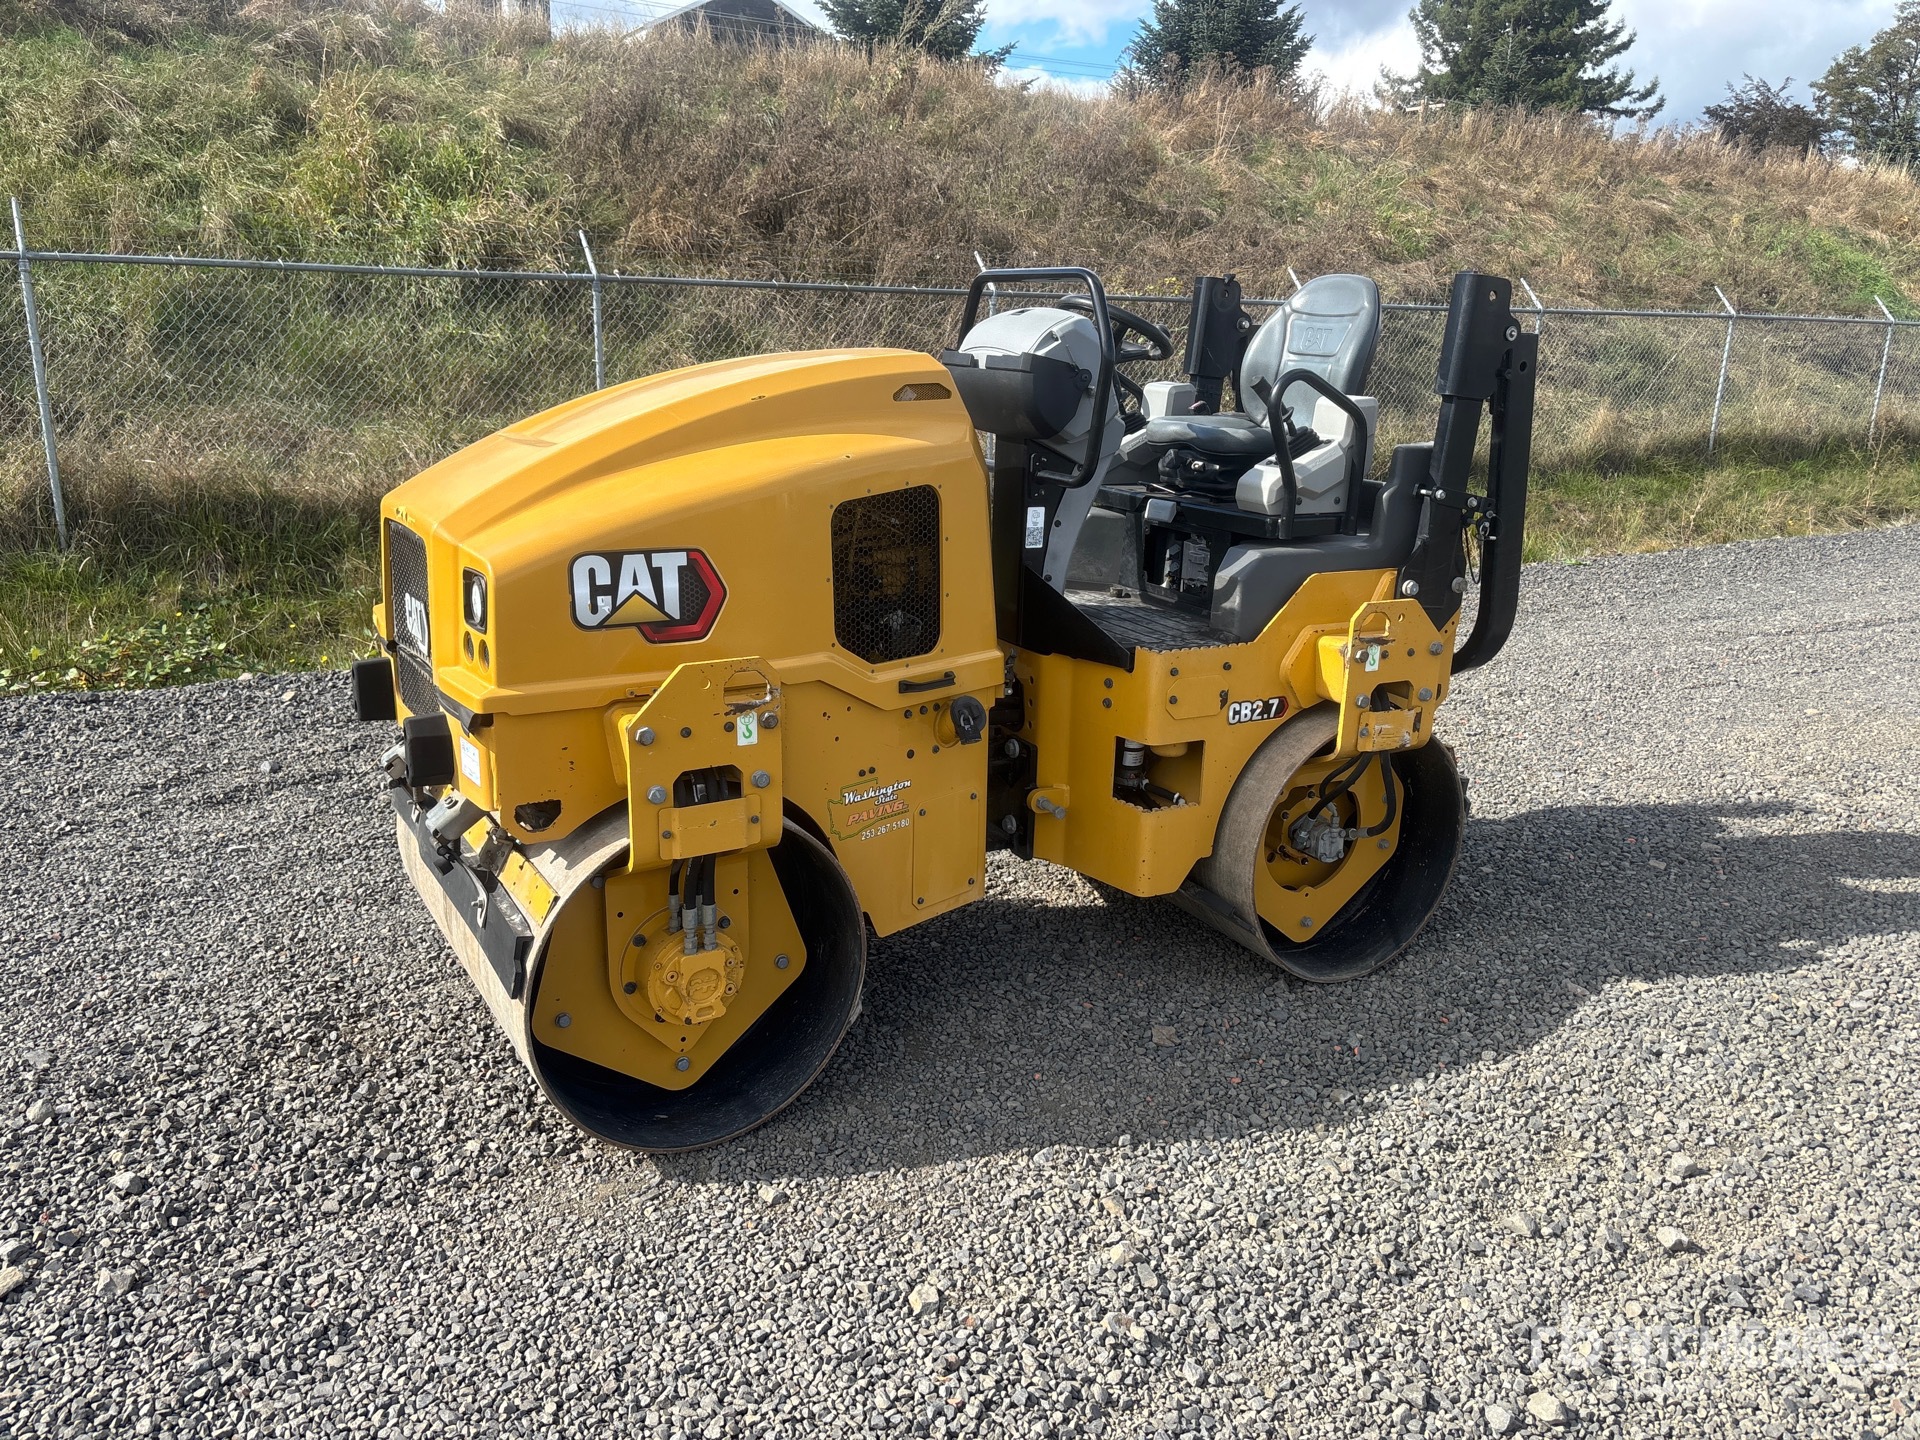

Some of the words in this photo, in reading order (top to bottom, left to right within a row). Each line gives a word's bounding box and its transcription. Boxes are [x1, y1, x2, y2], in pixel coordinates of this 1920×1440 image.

[1300, 326, 1333, 351] CAT
[572, 551, 688, 627] CAT
[405, 592, 426, 643] CAT
[1228, 698, 1280, 724] CB2.7
[843, 780, 911, 805] Washington
[875, 793, 898, 805] State
[847, 800, 904, 826] PAVING
[861, 818, 910, 840] 253.267.5180
